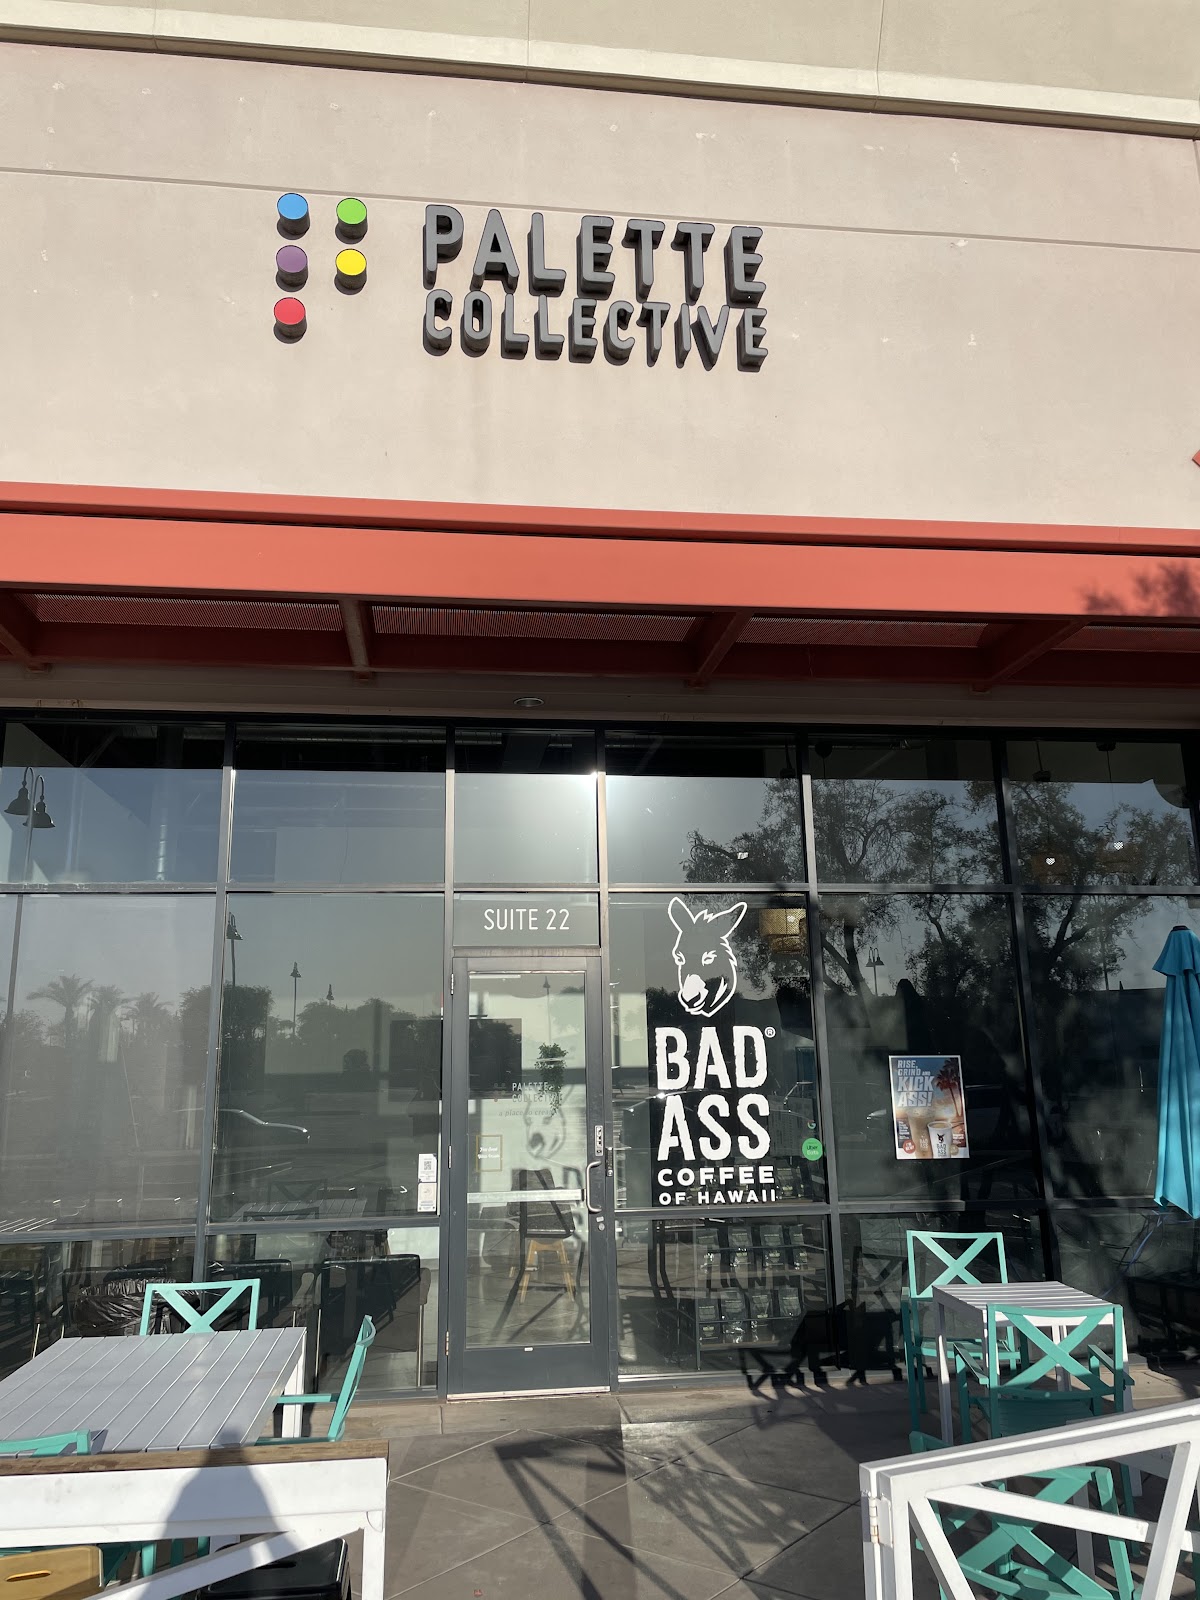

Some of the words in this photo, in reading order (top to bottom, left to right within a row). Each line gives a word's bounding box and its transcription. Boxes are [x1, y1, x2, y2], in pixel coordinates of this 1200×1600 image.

[423, 204, 765, 304] PALETTE
[423, 289, 768, 370] COLLECTIVE
[483, 908, 539, 931] SUITE
[546, 908, 570, 931] 22
[512, 1082, 548, 1091] PALETTE
[897, 1076, 935, 1092] KICK
[897, 1091, 933, 1107] ASS!
[658, 1094, 771, 1161] ASS
[657, 1166, 775, 1187] COFFEE
[658, 1192, 687, 1206] OF
[697, 1189, 776, 1204] HAWAII
